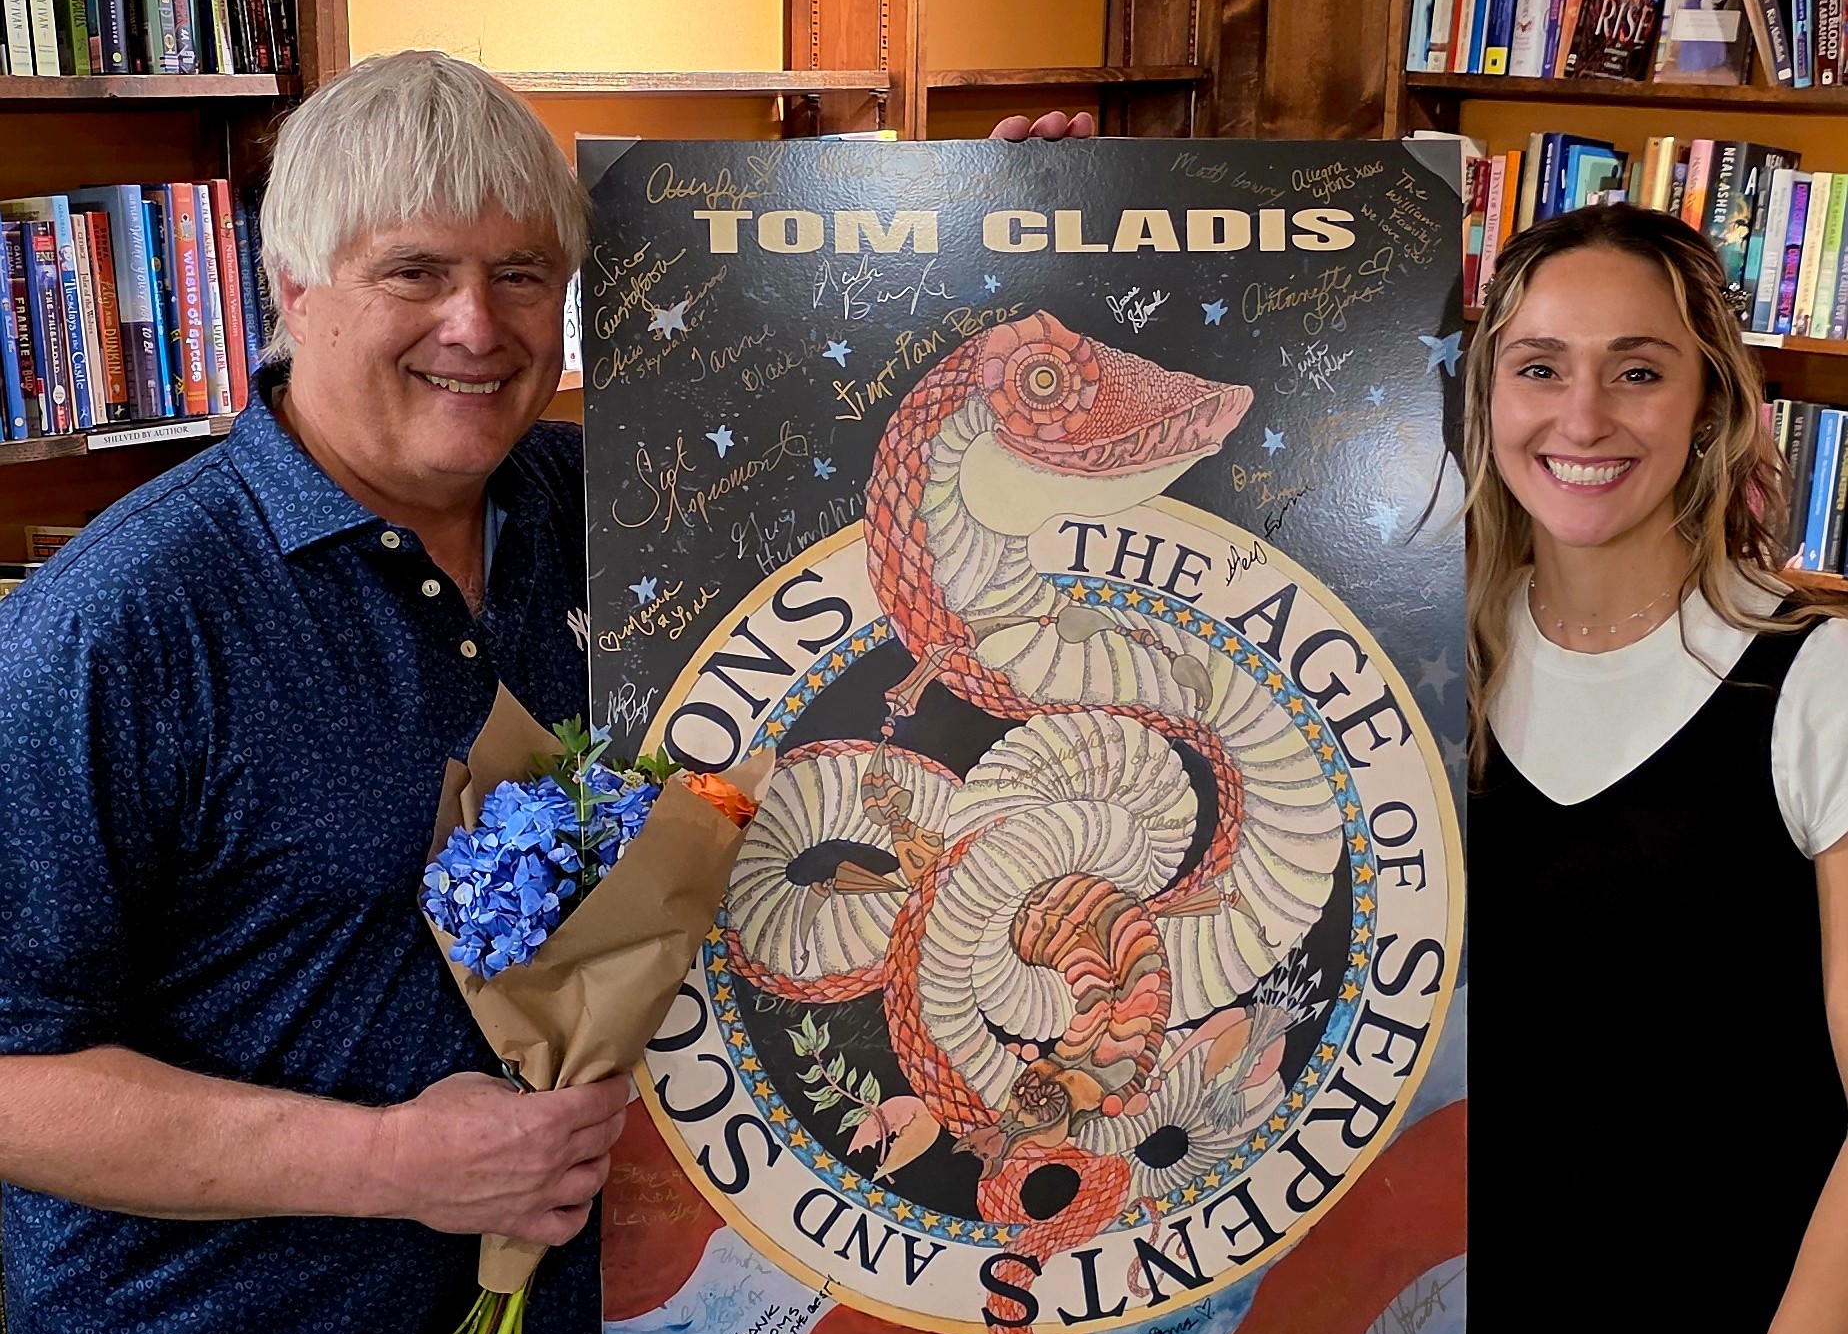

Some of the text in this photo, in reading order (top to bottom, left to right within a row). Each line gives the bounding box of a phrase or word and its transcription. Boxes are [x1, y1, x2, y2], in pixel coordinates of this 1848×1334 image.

[1827, 18, 1841, 60] BLOOD
[1396, 168, 1429, 201] The
[1713, 147, 1736, 224] NEAL ASHER
[693, 208, 1356, 254] TOM CLADIS
[225, 244, 240, 337] Nicholas on Vacation
[241, 269, 252, 310] DEEPEST
[14, 297, 31, 356] FRANKIE
[63, 278, 76, 332] Tuesdays
[71, 352, 85, 390] Castle
[105, 328, 122, 375] DUNKIN
[186, 328, 203, 383] space
[246, 313, 257, 351] BREATH
[832, 380, 893, 421] Jim
[103, 426, 189, 444] SHELVED BY AUTHOR
[1058, 520, 1212, 604] THE
[1225, 581, 1413, 770] AGE
[1367, 800, 1428, 894] OF
[646, 568, 854, 1197] SCOONS
[979, 932, 1445, 1329] SERPENTS
[792, 1187, 949, 1287] AND
